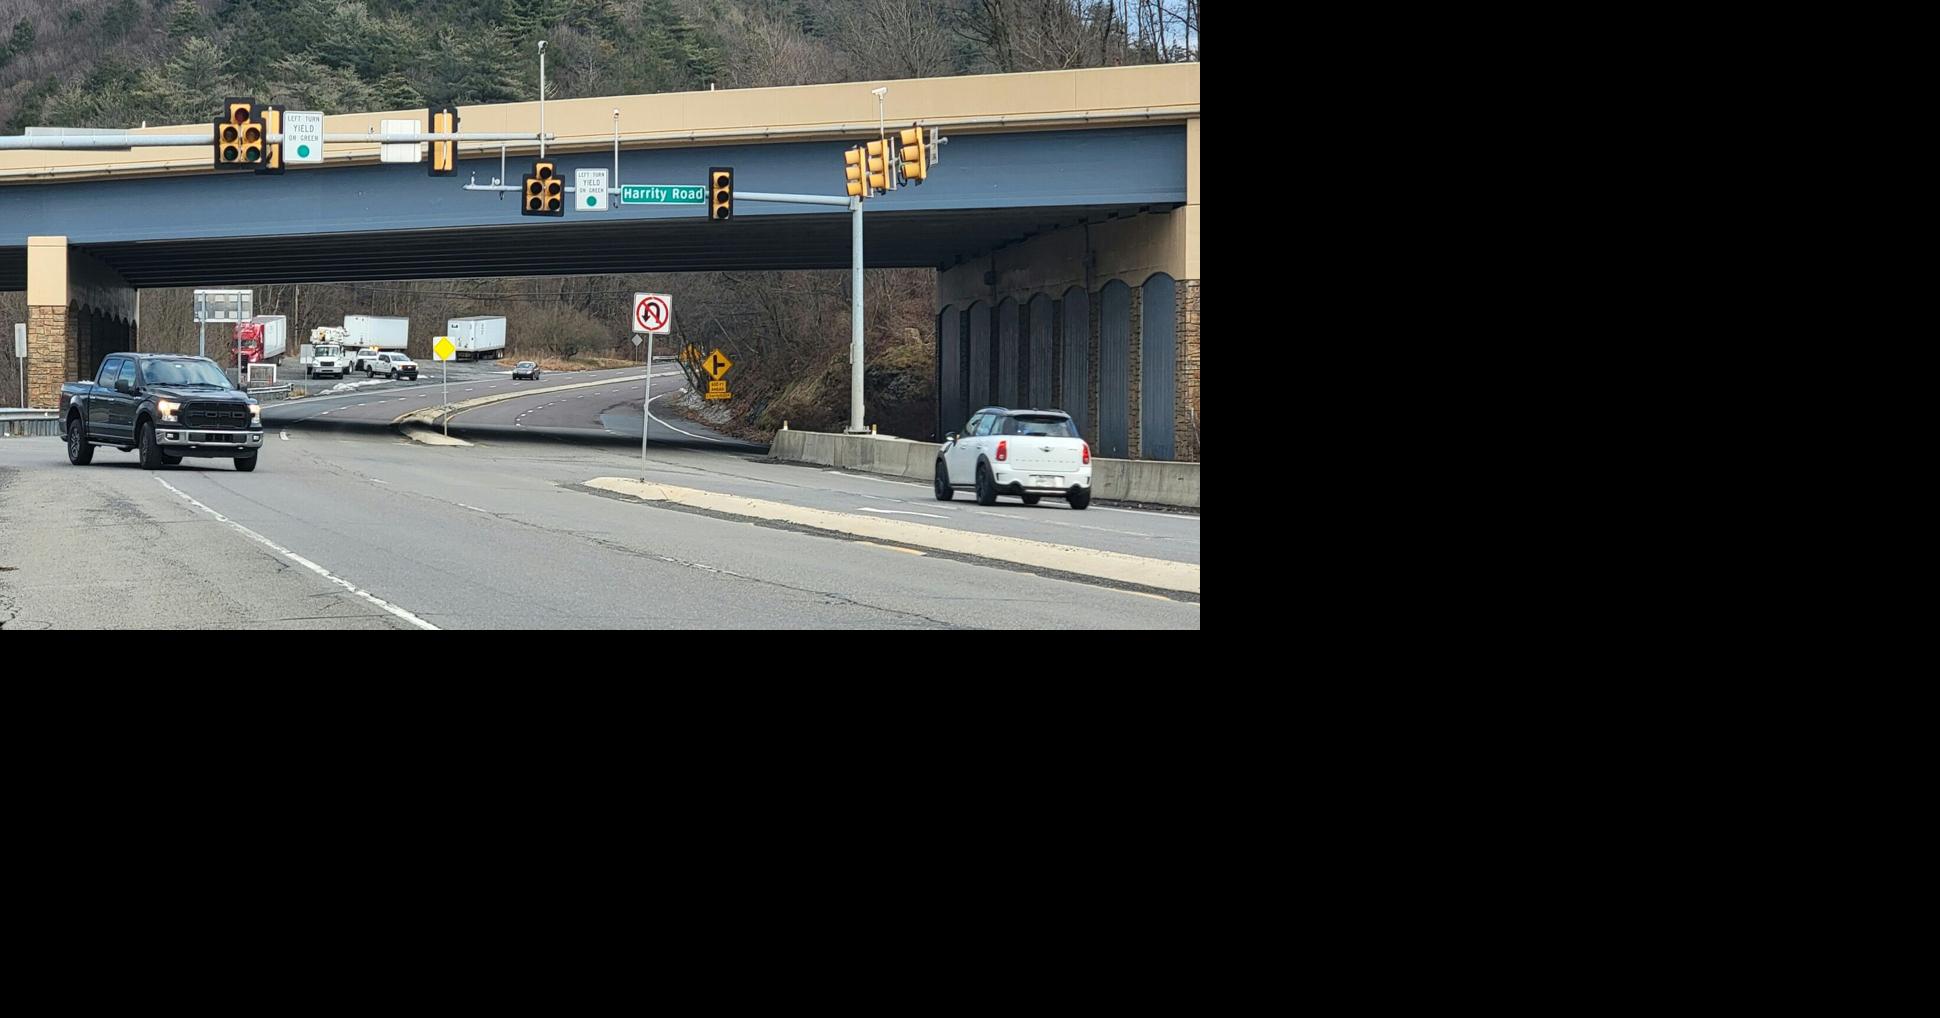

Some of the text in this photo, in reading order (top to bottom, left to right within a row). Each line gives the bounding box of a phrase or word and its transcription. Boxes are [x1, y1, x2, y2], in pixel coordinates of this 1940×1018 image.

[293, 124, 315, 133] YIELD
[300, 134, 319, 142] GREEN
[624, 187, 703, 202] Harrity Road
[190, 410, 244, 418] FORD
